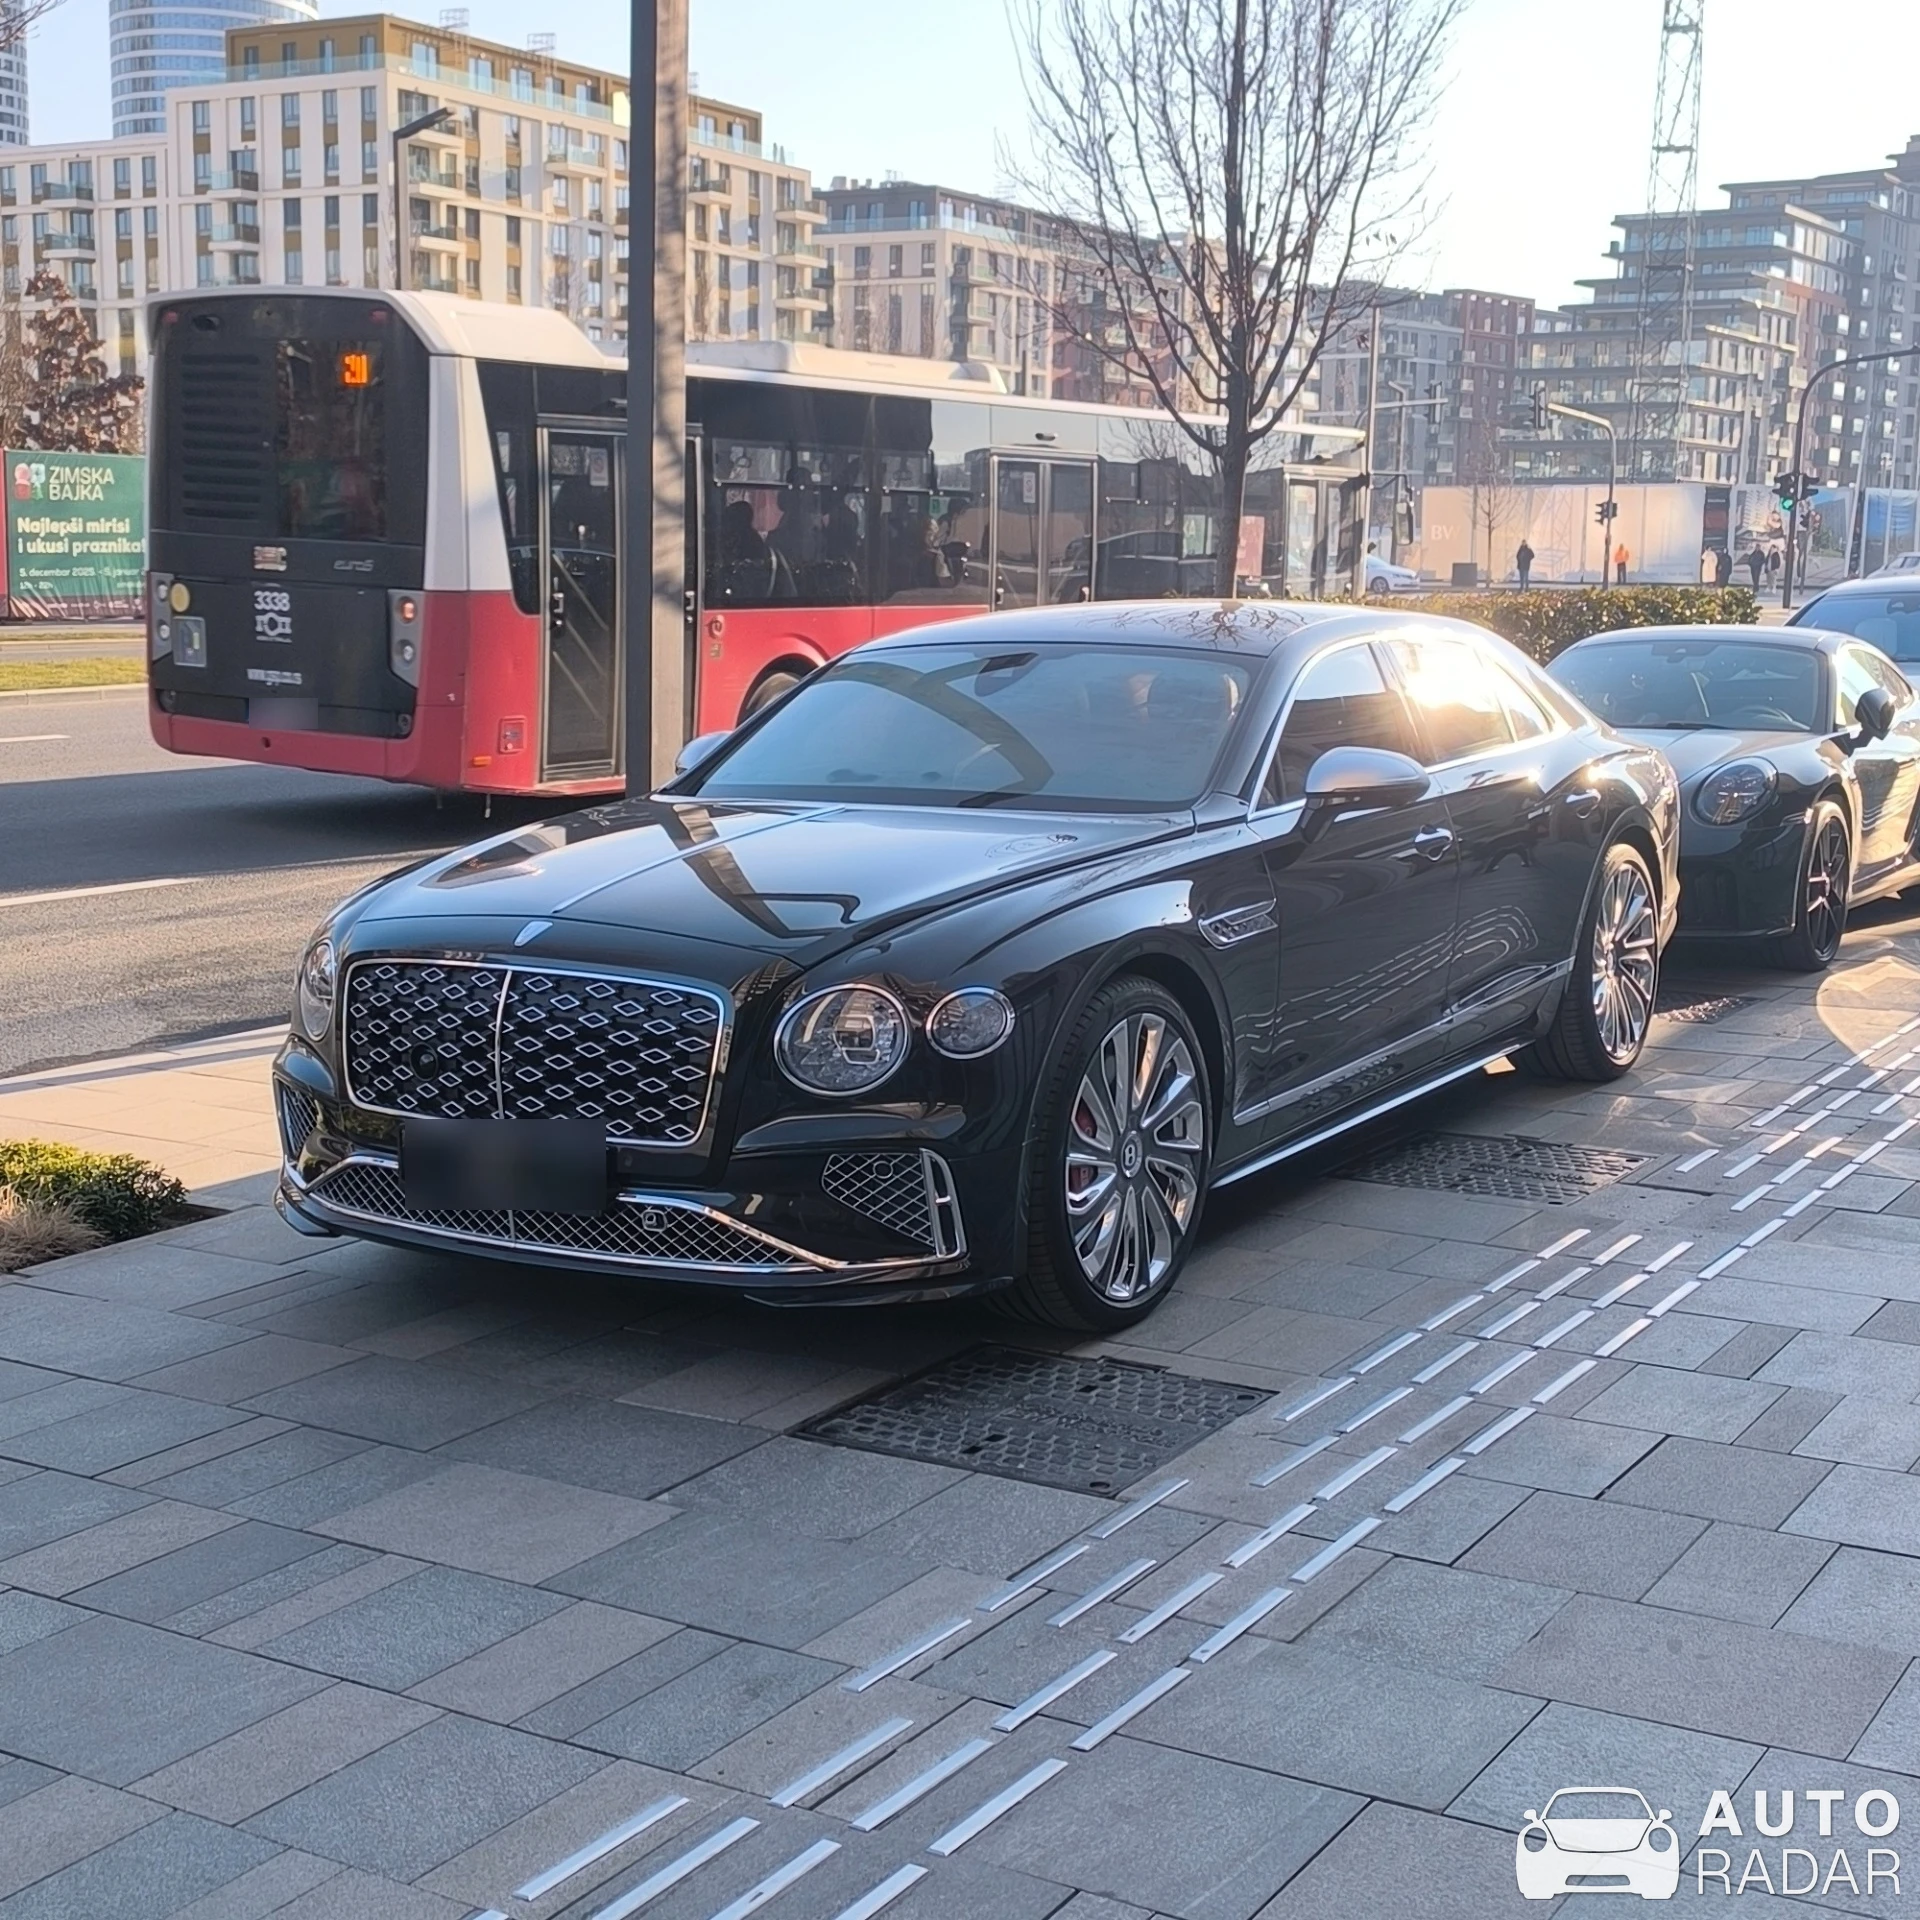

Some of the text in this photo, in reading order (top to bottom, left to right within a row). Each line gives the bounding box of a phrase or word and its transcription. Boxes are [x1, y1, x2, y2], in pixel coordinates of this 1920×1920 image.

[49, 466, 115, 484] ZIMSKA
[49, 484, 104, 501] BAJKA
[17, 516, 130, 537] Najlepši mirisi
[18, 537, 24, 553] i
[26, 537, 69, 553] ukusi
[253, 590, 291, 611] 3338
